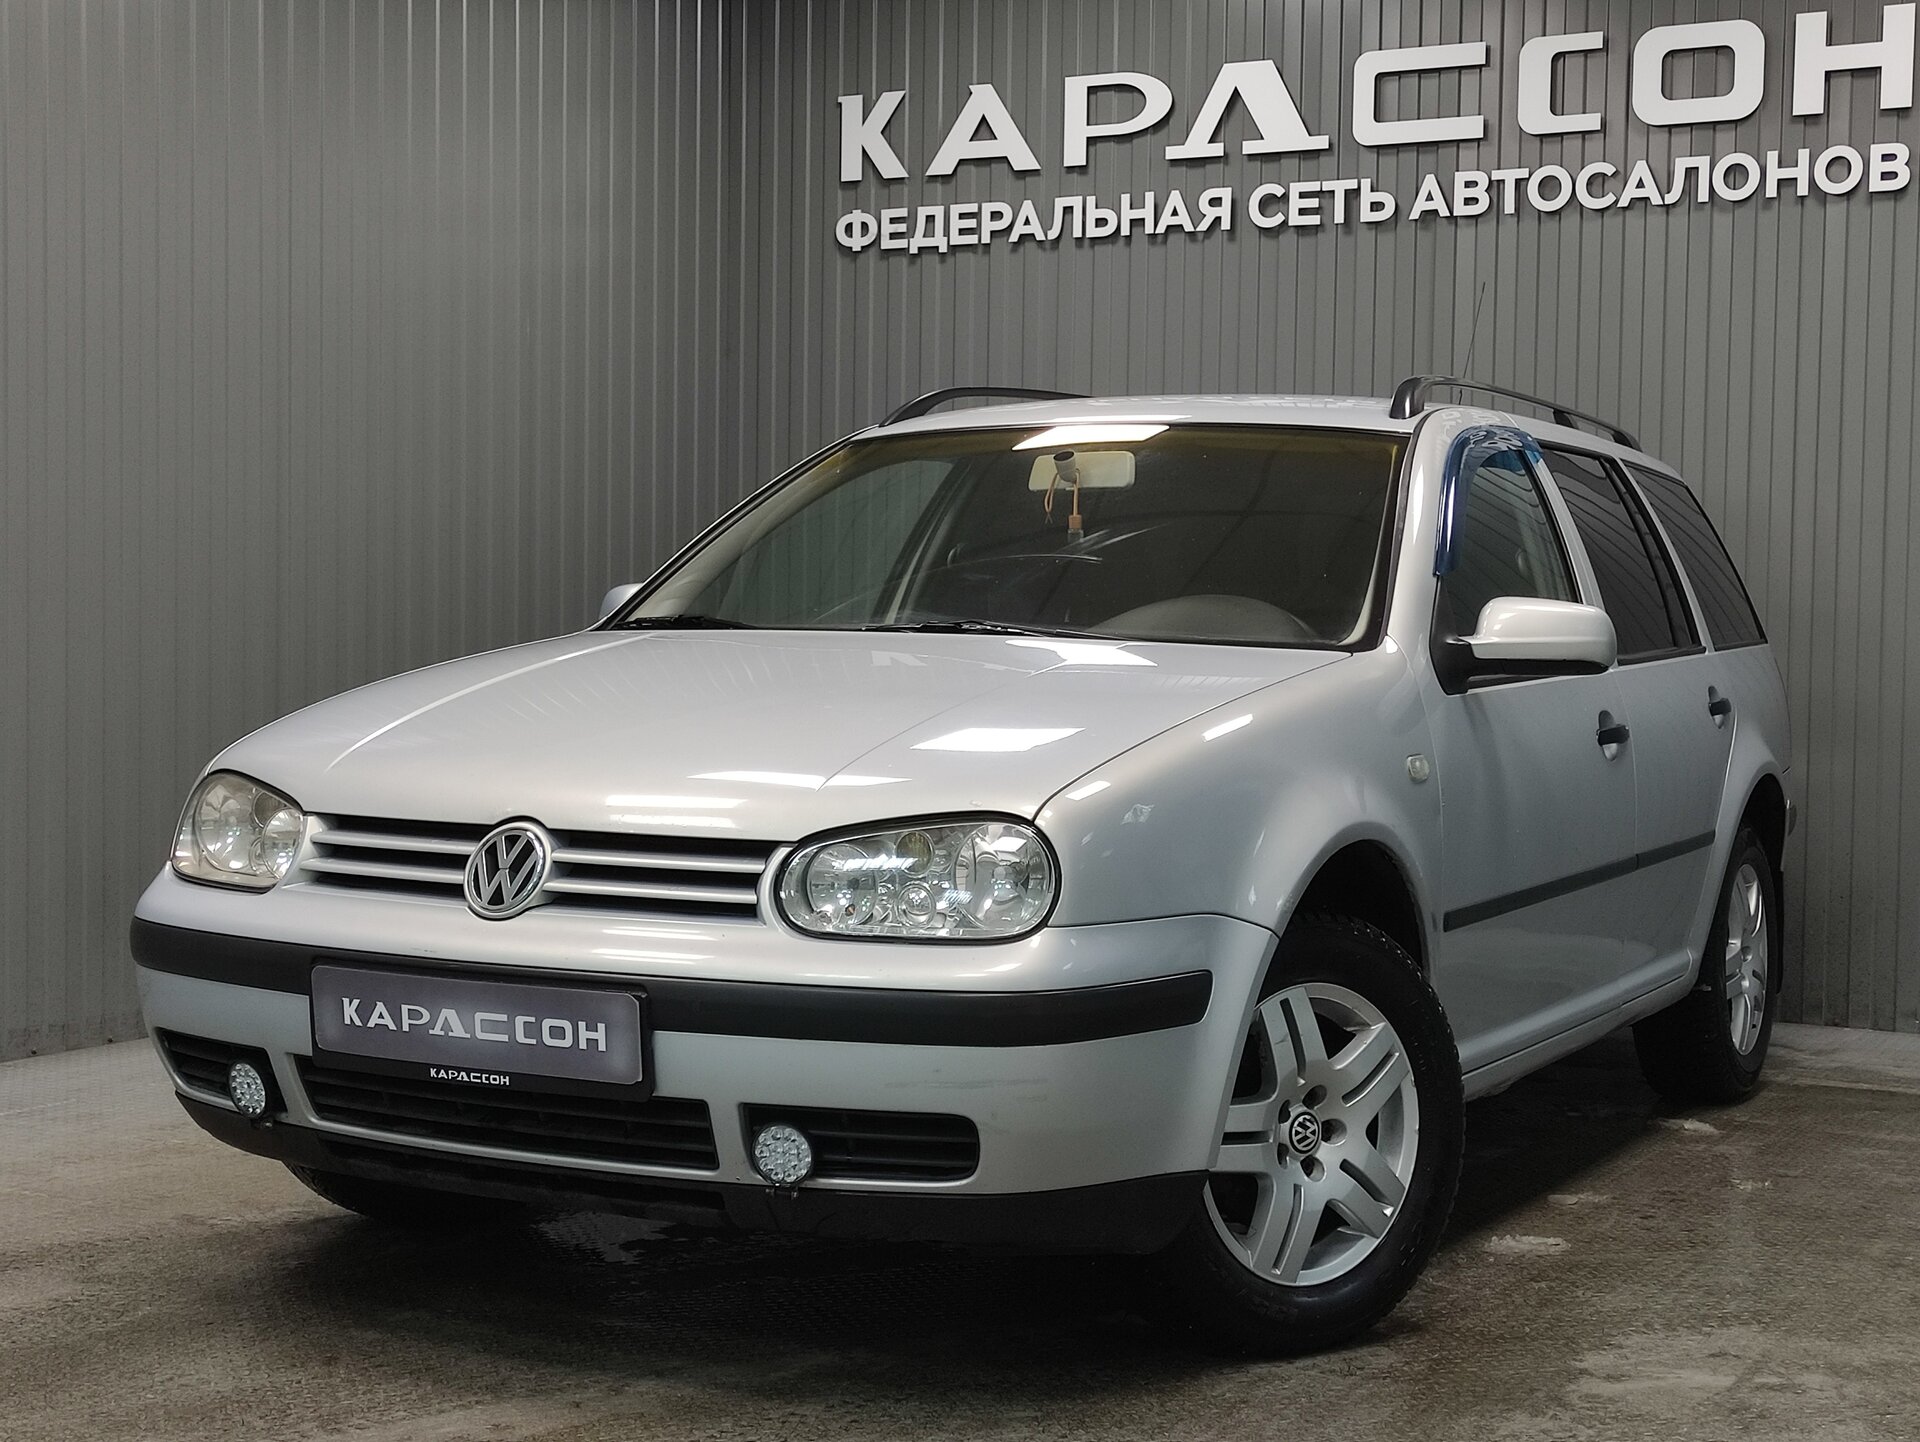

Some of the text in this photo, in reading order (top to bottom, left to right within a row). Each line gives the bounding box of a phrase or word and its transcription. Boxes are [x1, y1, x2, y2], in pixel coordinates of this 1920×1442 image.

[835, 142, 1911, 255] ФЕДЕРАЛЬНАЯ СЕТЬ АВТОСАЛОНОВ
